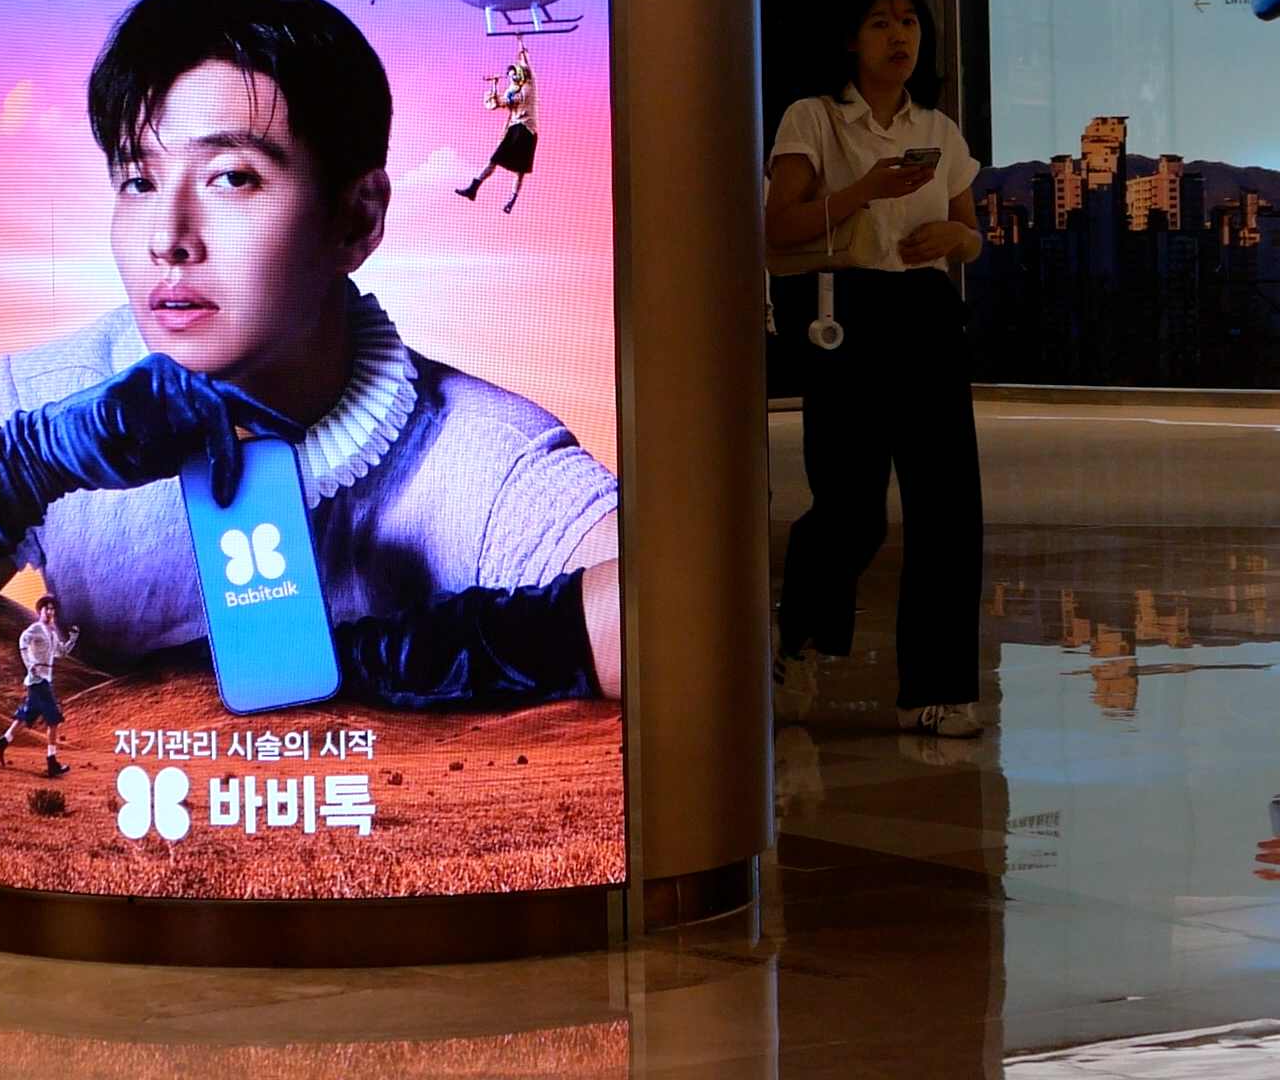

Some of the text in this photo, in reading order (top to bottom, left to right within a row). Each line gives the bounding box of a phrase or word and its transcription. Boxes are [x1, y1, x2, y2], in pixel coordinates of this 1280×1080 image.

[224, 581, 300, 608] Babitalk
[114, 729, 376, 761] 자기관리 시술의 시작
[208, 774, 376, 836] 바비톡
